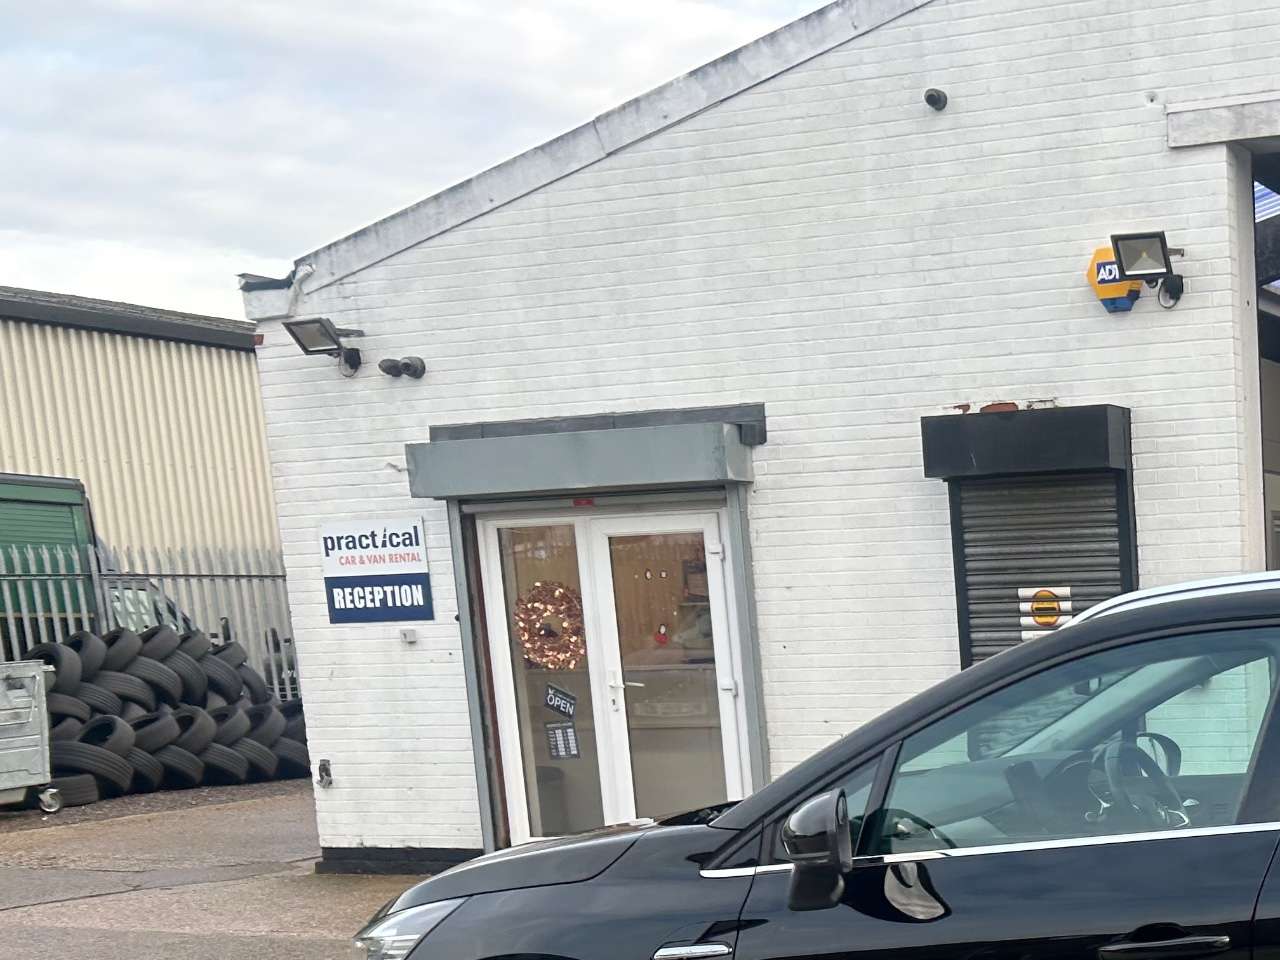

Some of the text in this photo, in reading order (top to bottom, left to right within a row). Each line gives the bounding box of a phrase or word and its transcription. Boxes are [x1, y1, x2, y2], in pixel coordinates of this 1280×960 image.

[322, 525, 420, 557] practical
[339, 552, 422, 566] CAR & VAN RENTAL
[332, 584, 424, 609] RECEPTION
[547, 694, 574, 715] OPEN
